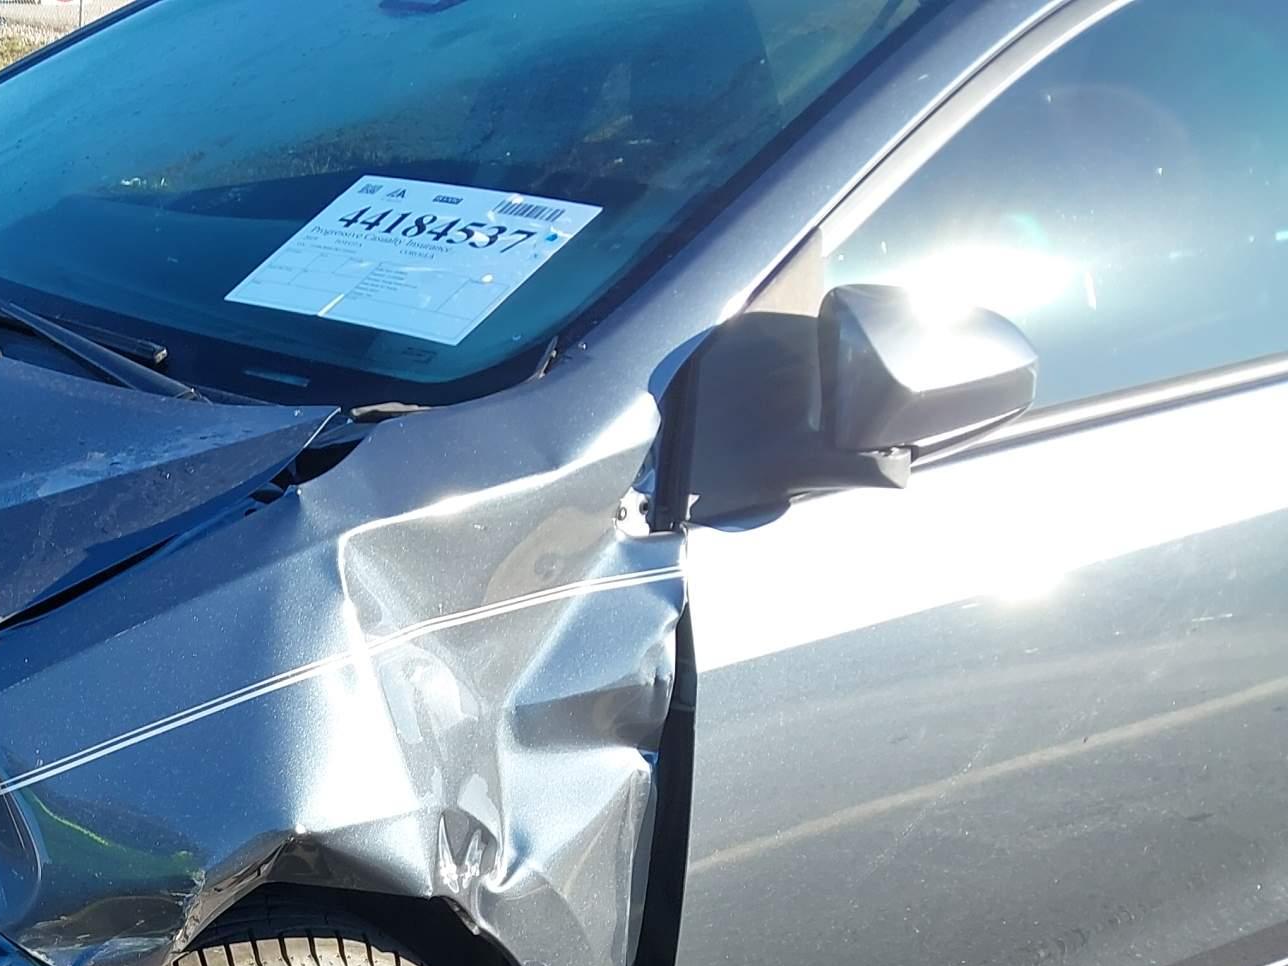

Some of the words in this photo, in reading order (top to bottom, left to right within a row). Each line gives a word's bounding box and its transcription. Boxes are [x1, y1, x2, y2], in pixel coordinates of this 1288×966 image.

[310, 225, 364, 241] Progressive
[364, 232, 403, 247] Casualty
[405, 238, 451, 255] Insurance
[338, 205, 537, 254] 44184537
